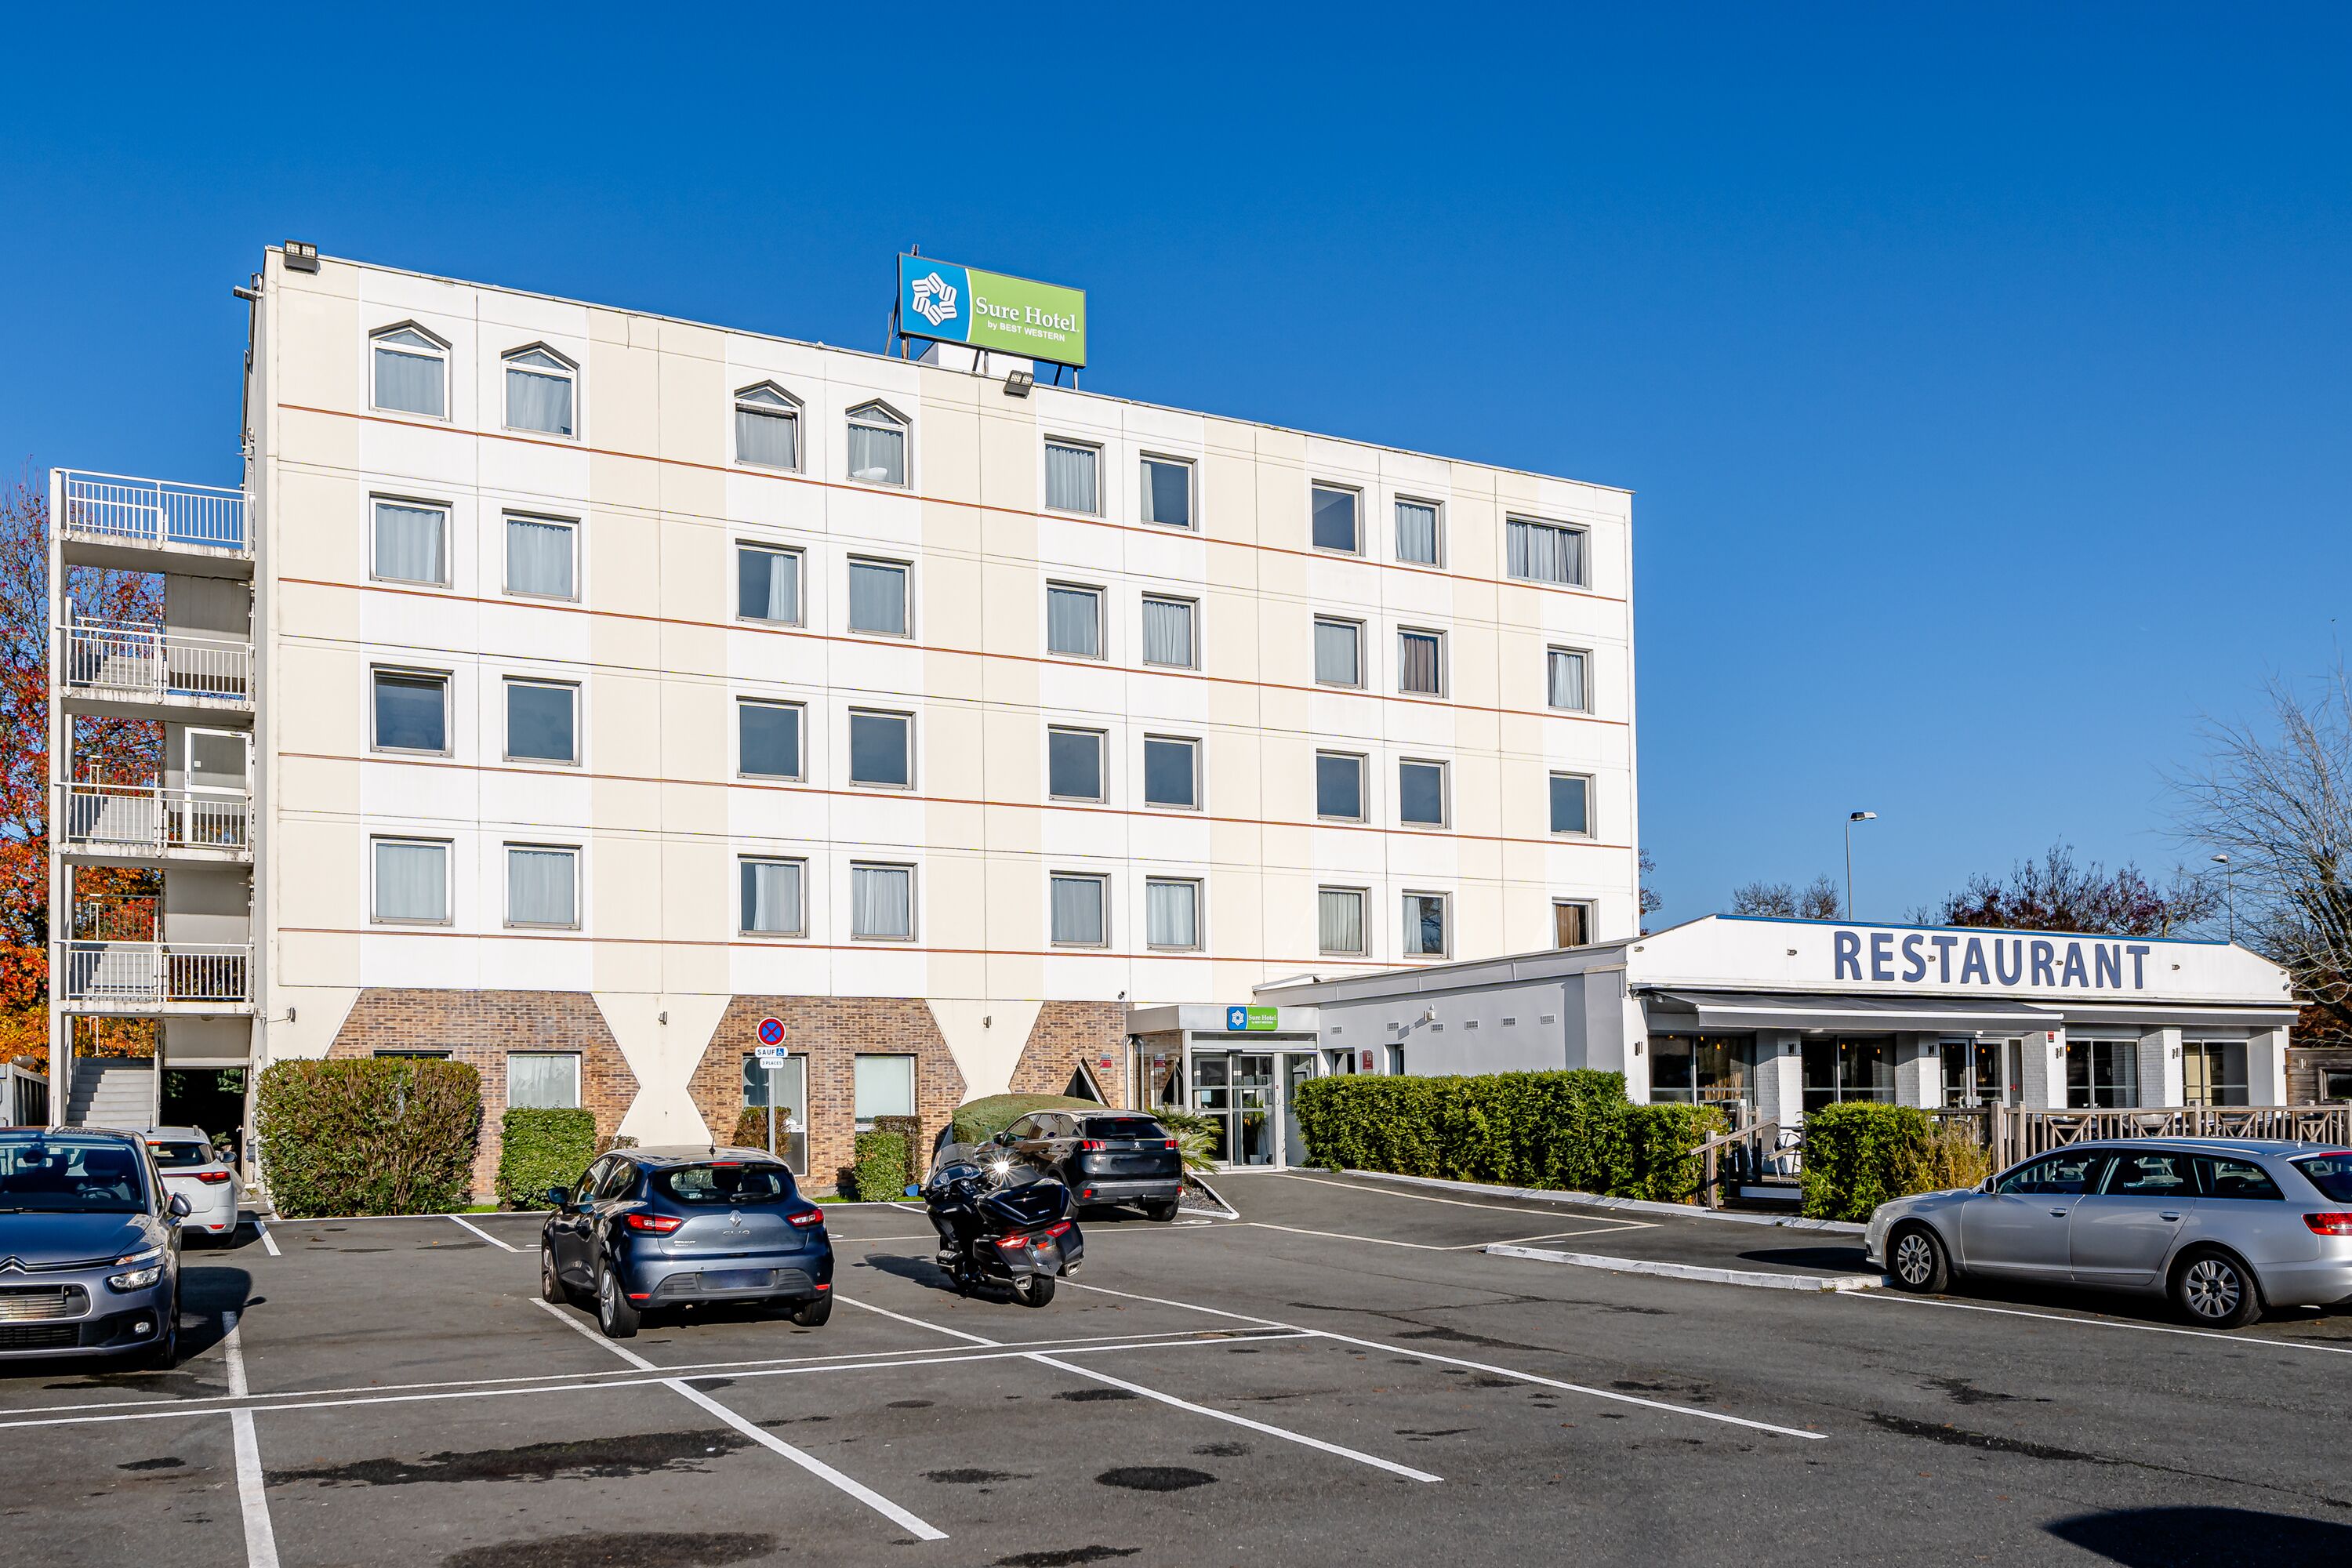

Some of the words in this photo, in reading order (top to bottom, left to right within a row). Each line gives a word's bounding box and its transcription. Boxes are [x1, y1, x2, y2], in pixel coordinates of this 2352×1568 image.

[976, 297, 1019, 321] Sure
[988, 320, 997, 331] by
[1000, 322, 1022, 334] BEST
[1024, 327, 1065, 342] WESTERN
[1835, 931, 2151, 989] RESTAURANT
